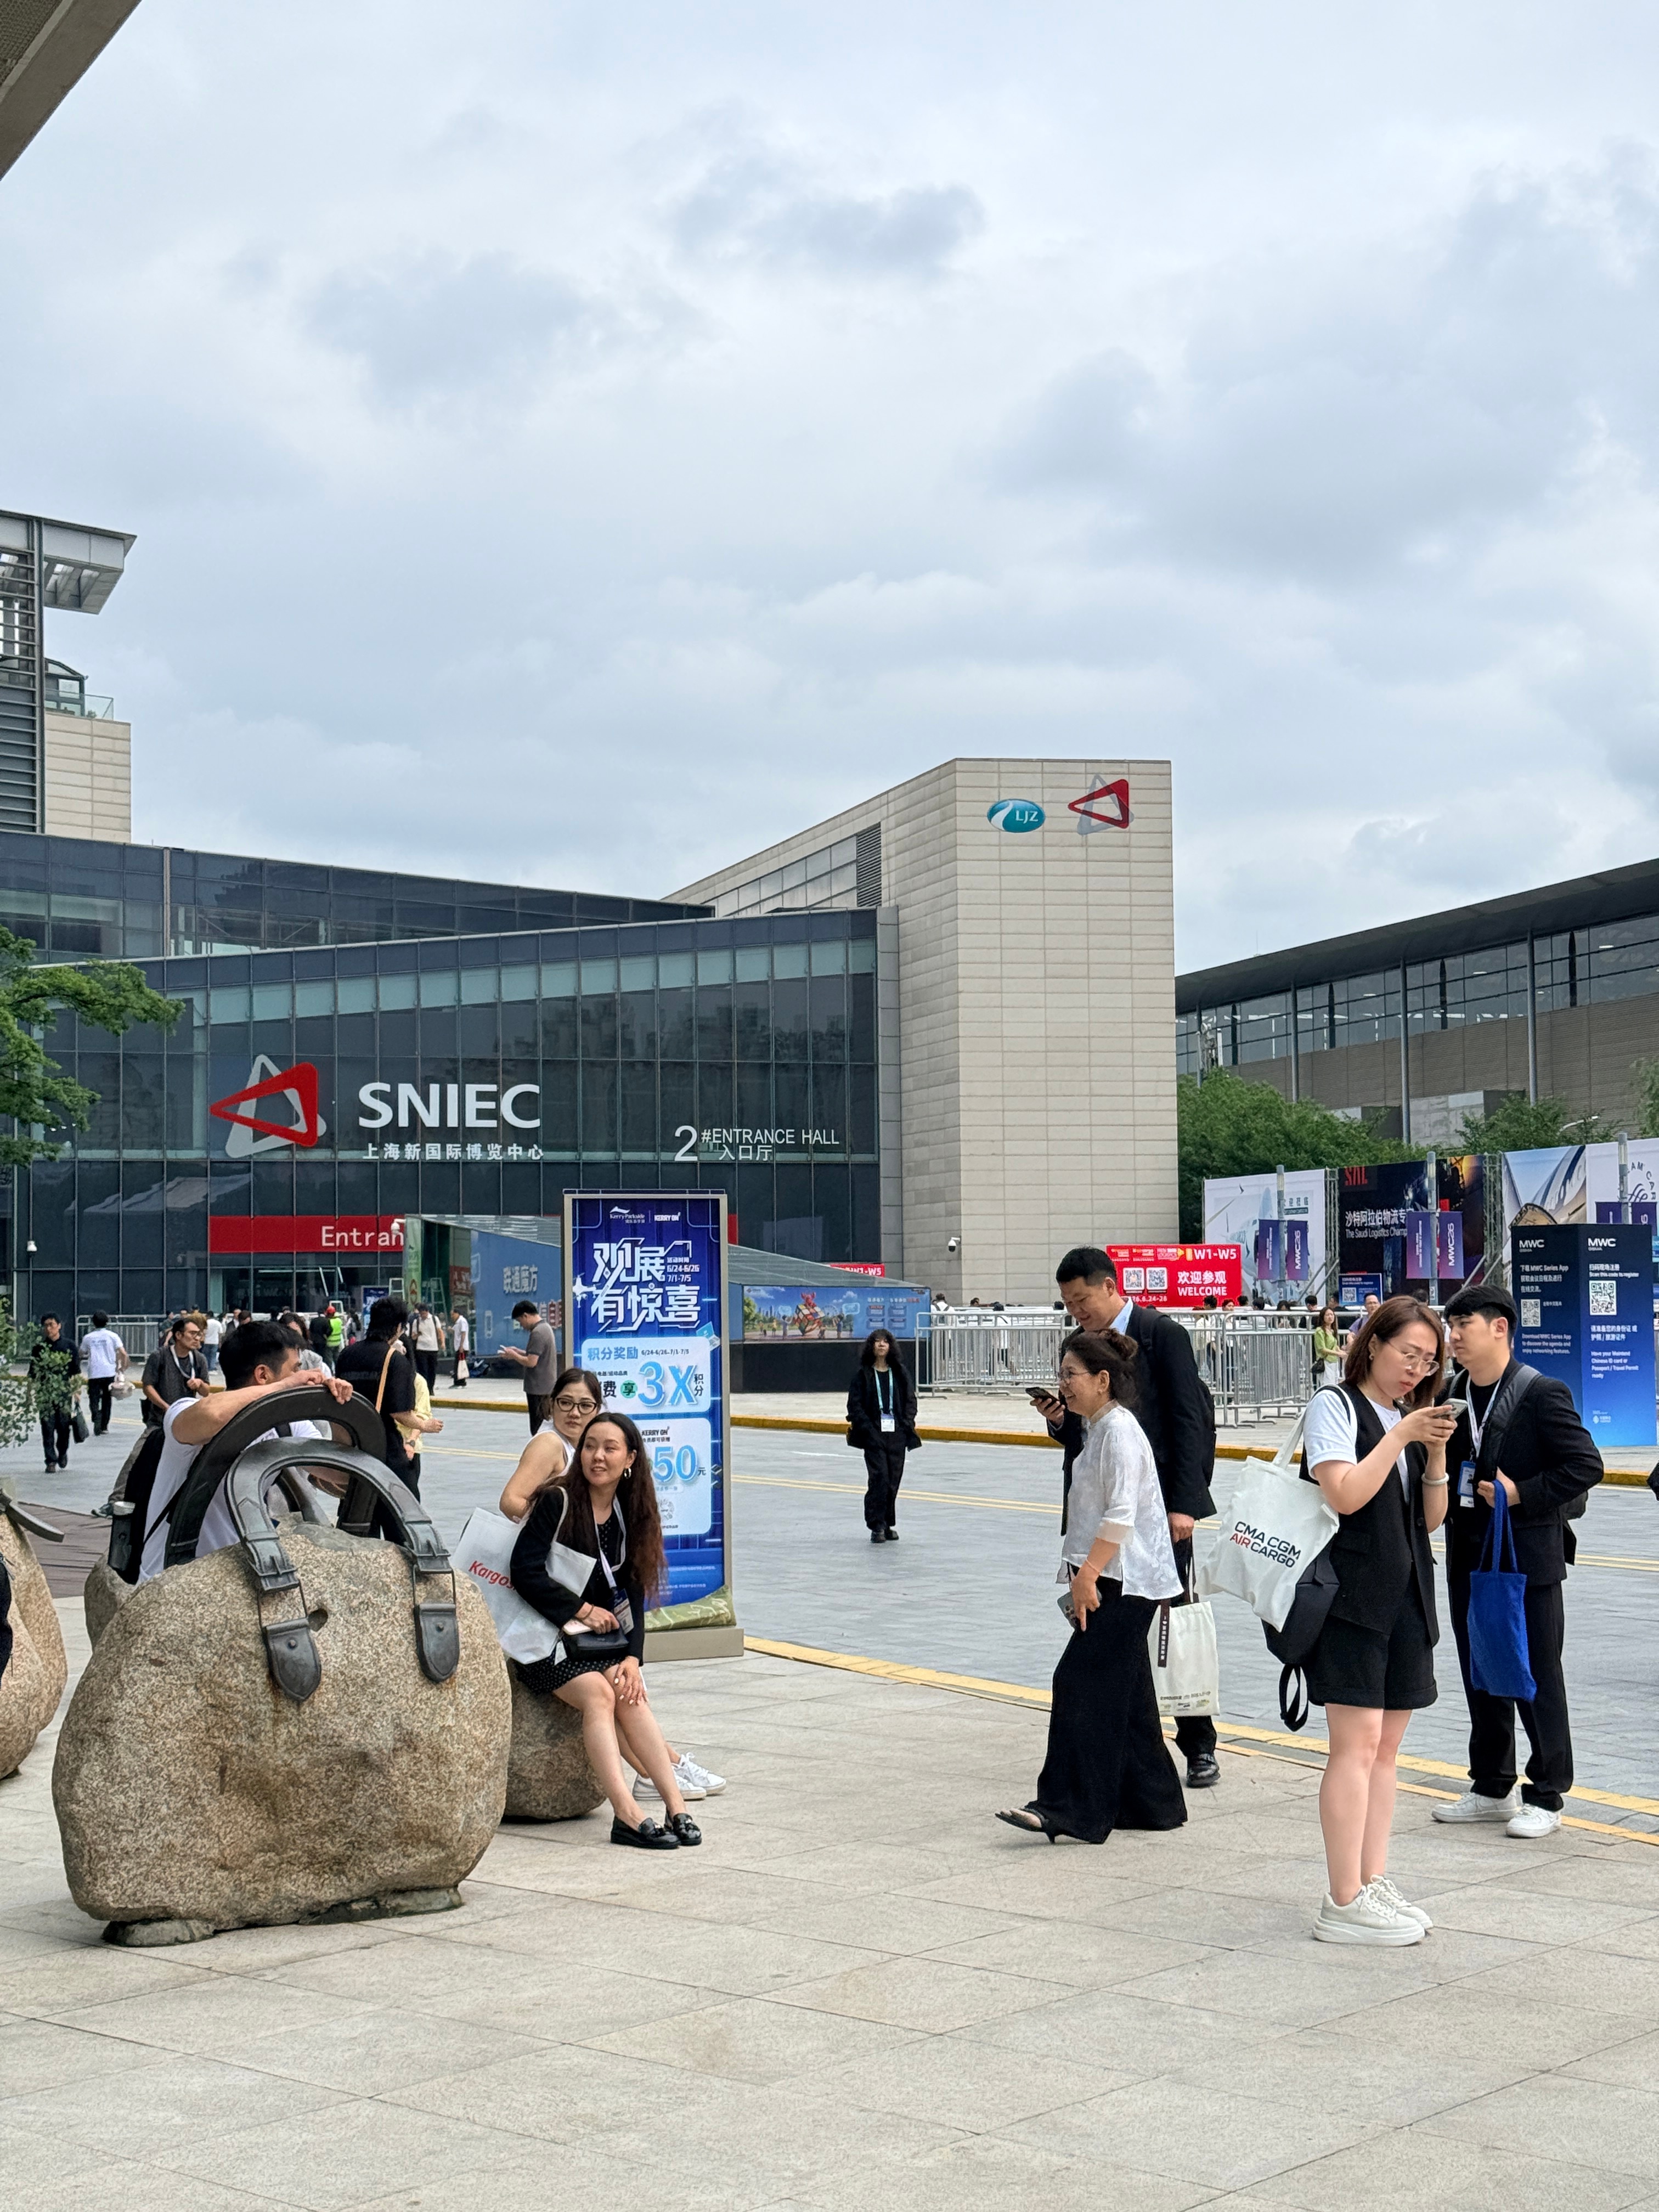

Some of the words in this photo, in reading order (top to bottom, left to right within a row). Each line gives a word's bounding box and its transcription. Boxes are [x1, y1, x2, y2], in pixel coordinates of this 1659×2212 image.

[1016, 810, 1039, 823] LJZ
[358, 1082, 541, 1129] SNIEC
[802, 1128, 840, 1144] HALL
[363, 1142, 544, 1161] 上海新国际博览中心
[719, 1144, 772, 1161] 入口厅
[1345, 1208, 1414, 1227] 沙特阿拉伯物流专
[1345, 1228, 1354, 1238] The
[1355, 1228, 1368, 1238] Saudi
[1369, 1228, 1389, 1239] Logistics
[1519, 1240, 1545, 1248] MWC
[1588, 1238, 1617, 1247] MWC
[1194, 1248, 1237, 1260] W1-W5
[1177, 1271, 1227, 1285] 欢迎参观
[1177, 1286, 1227, 1296] WELCOME
[591, 1285, 701, 1324] 有惊喜
[588, 1346, 638, 1361] 积分奖励
[623, 1382, 637, 1396] 享
[693, 1374, 704, 1397] 积分
[652, 1444, 697, 1482] 50
[697, 1467, 707, 1476] 元
[1234, 1521, 1265, 1543] CMA
[1267, 1536, 1301, 1560] CGM
[1229, 1532, 1251, 1548] AIR
[1250, 1541, 1296, 1568] CARGO
[468, 1560, 517, 1590] Kargos
